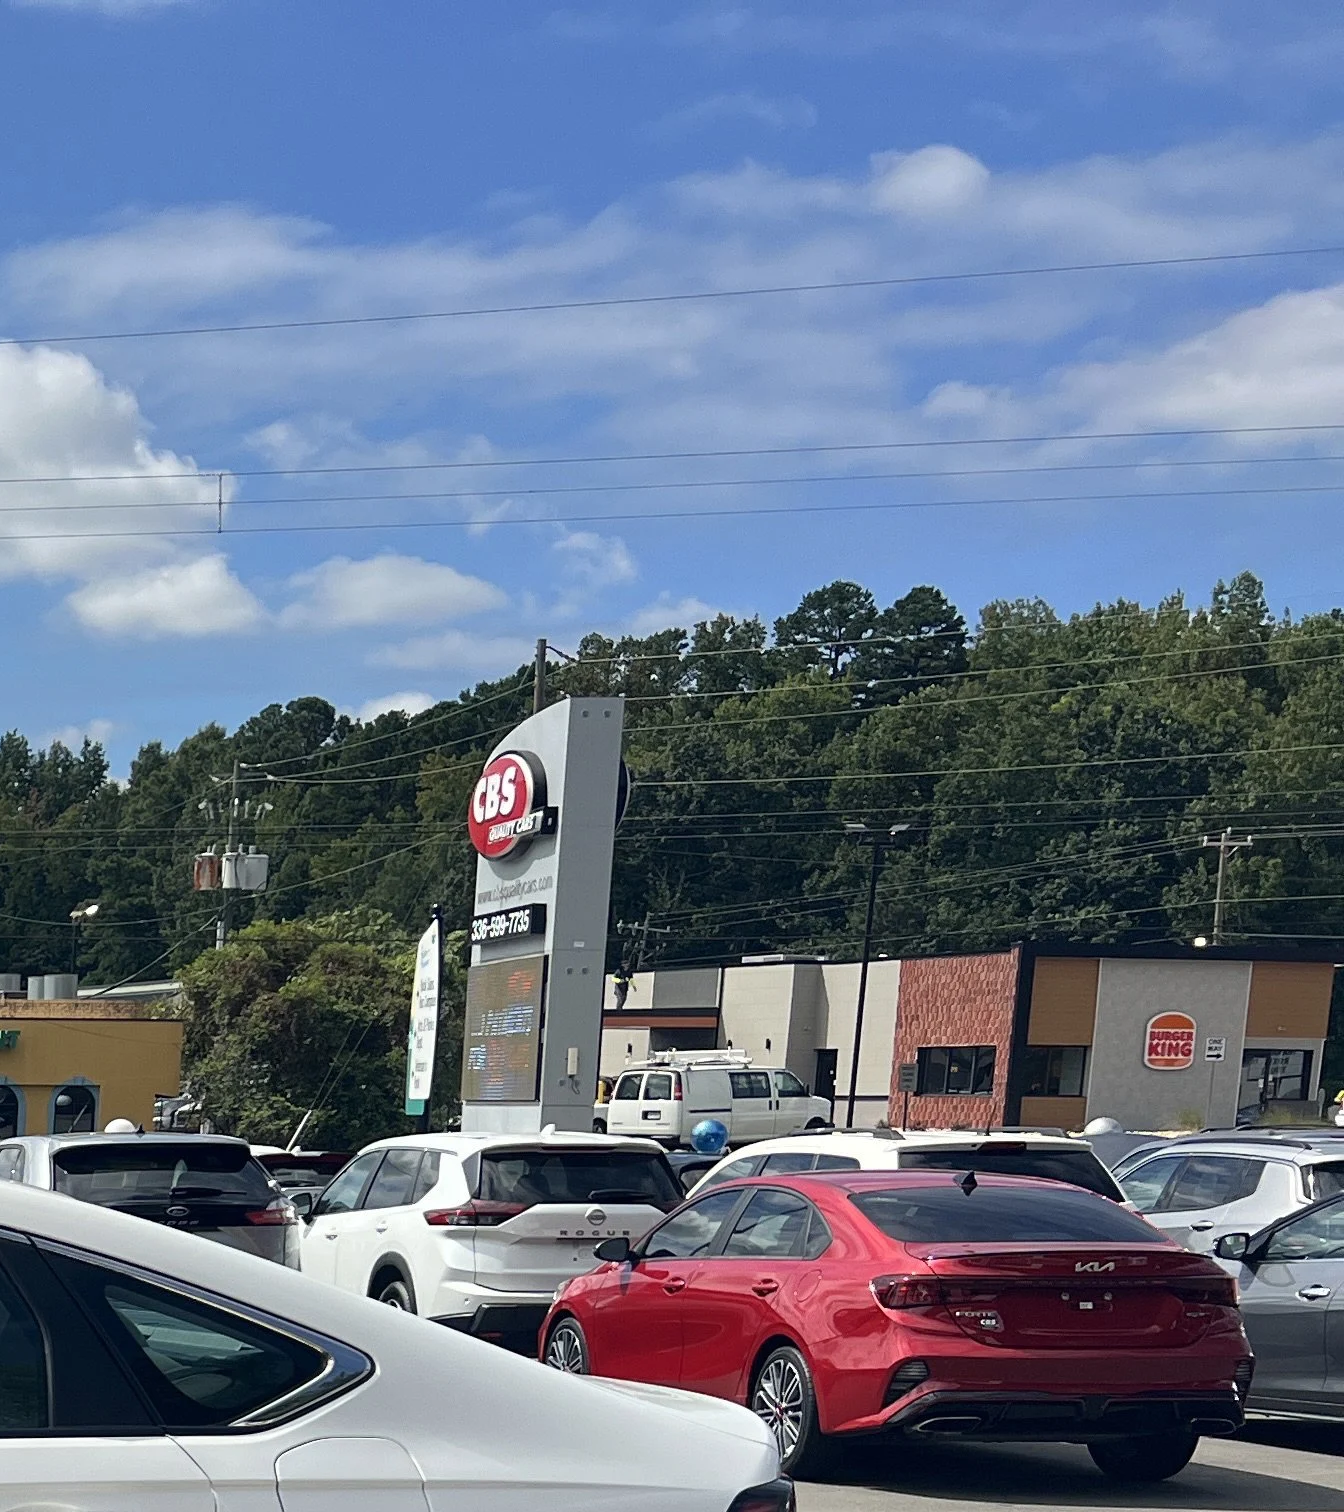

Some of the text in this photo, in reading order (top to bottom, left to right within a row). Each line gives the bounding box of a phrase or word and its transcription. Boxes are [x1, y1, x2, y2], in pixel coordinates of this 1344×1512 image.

[473, 766, 517, 824] CBS
[488, 815, 535, 842] QUALITY CARS
[471, 909, 530, 942] 336-599-7735
[1148, 1041, 1192, 1057] KING
[1149, 1031, 1193, 1041] BURGER
